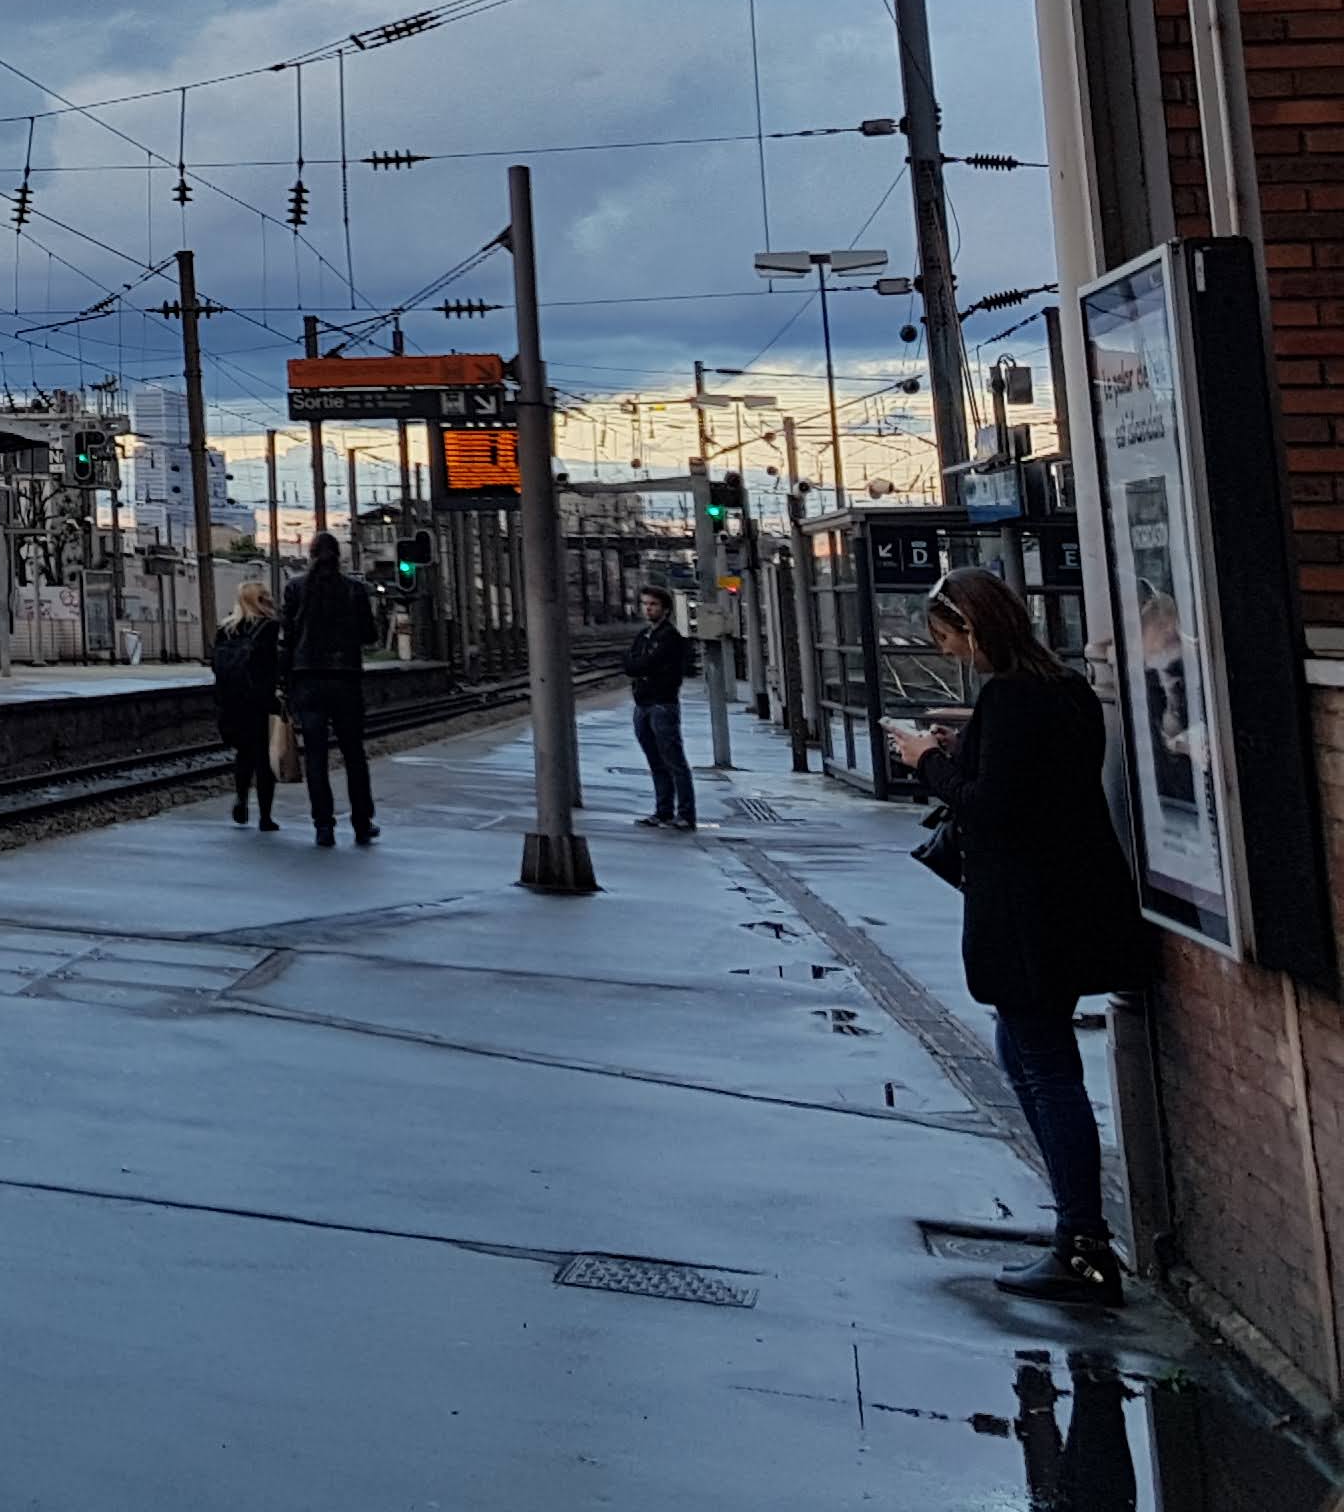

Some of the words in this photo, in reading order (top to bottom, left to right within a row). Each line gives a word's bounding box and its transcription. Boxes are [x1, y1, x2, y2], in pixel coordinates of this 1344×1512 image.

[291, 392, 345, 410] Sortie
[912, 548, 929, 564] D
[1064, 550, 1079, 566] E
